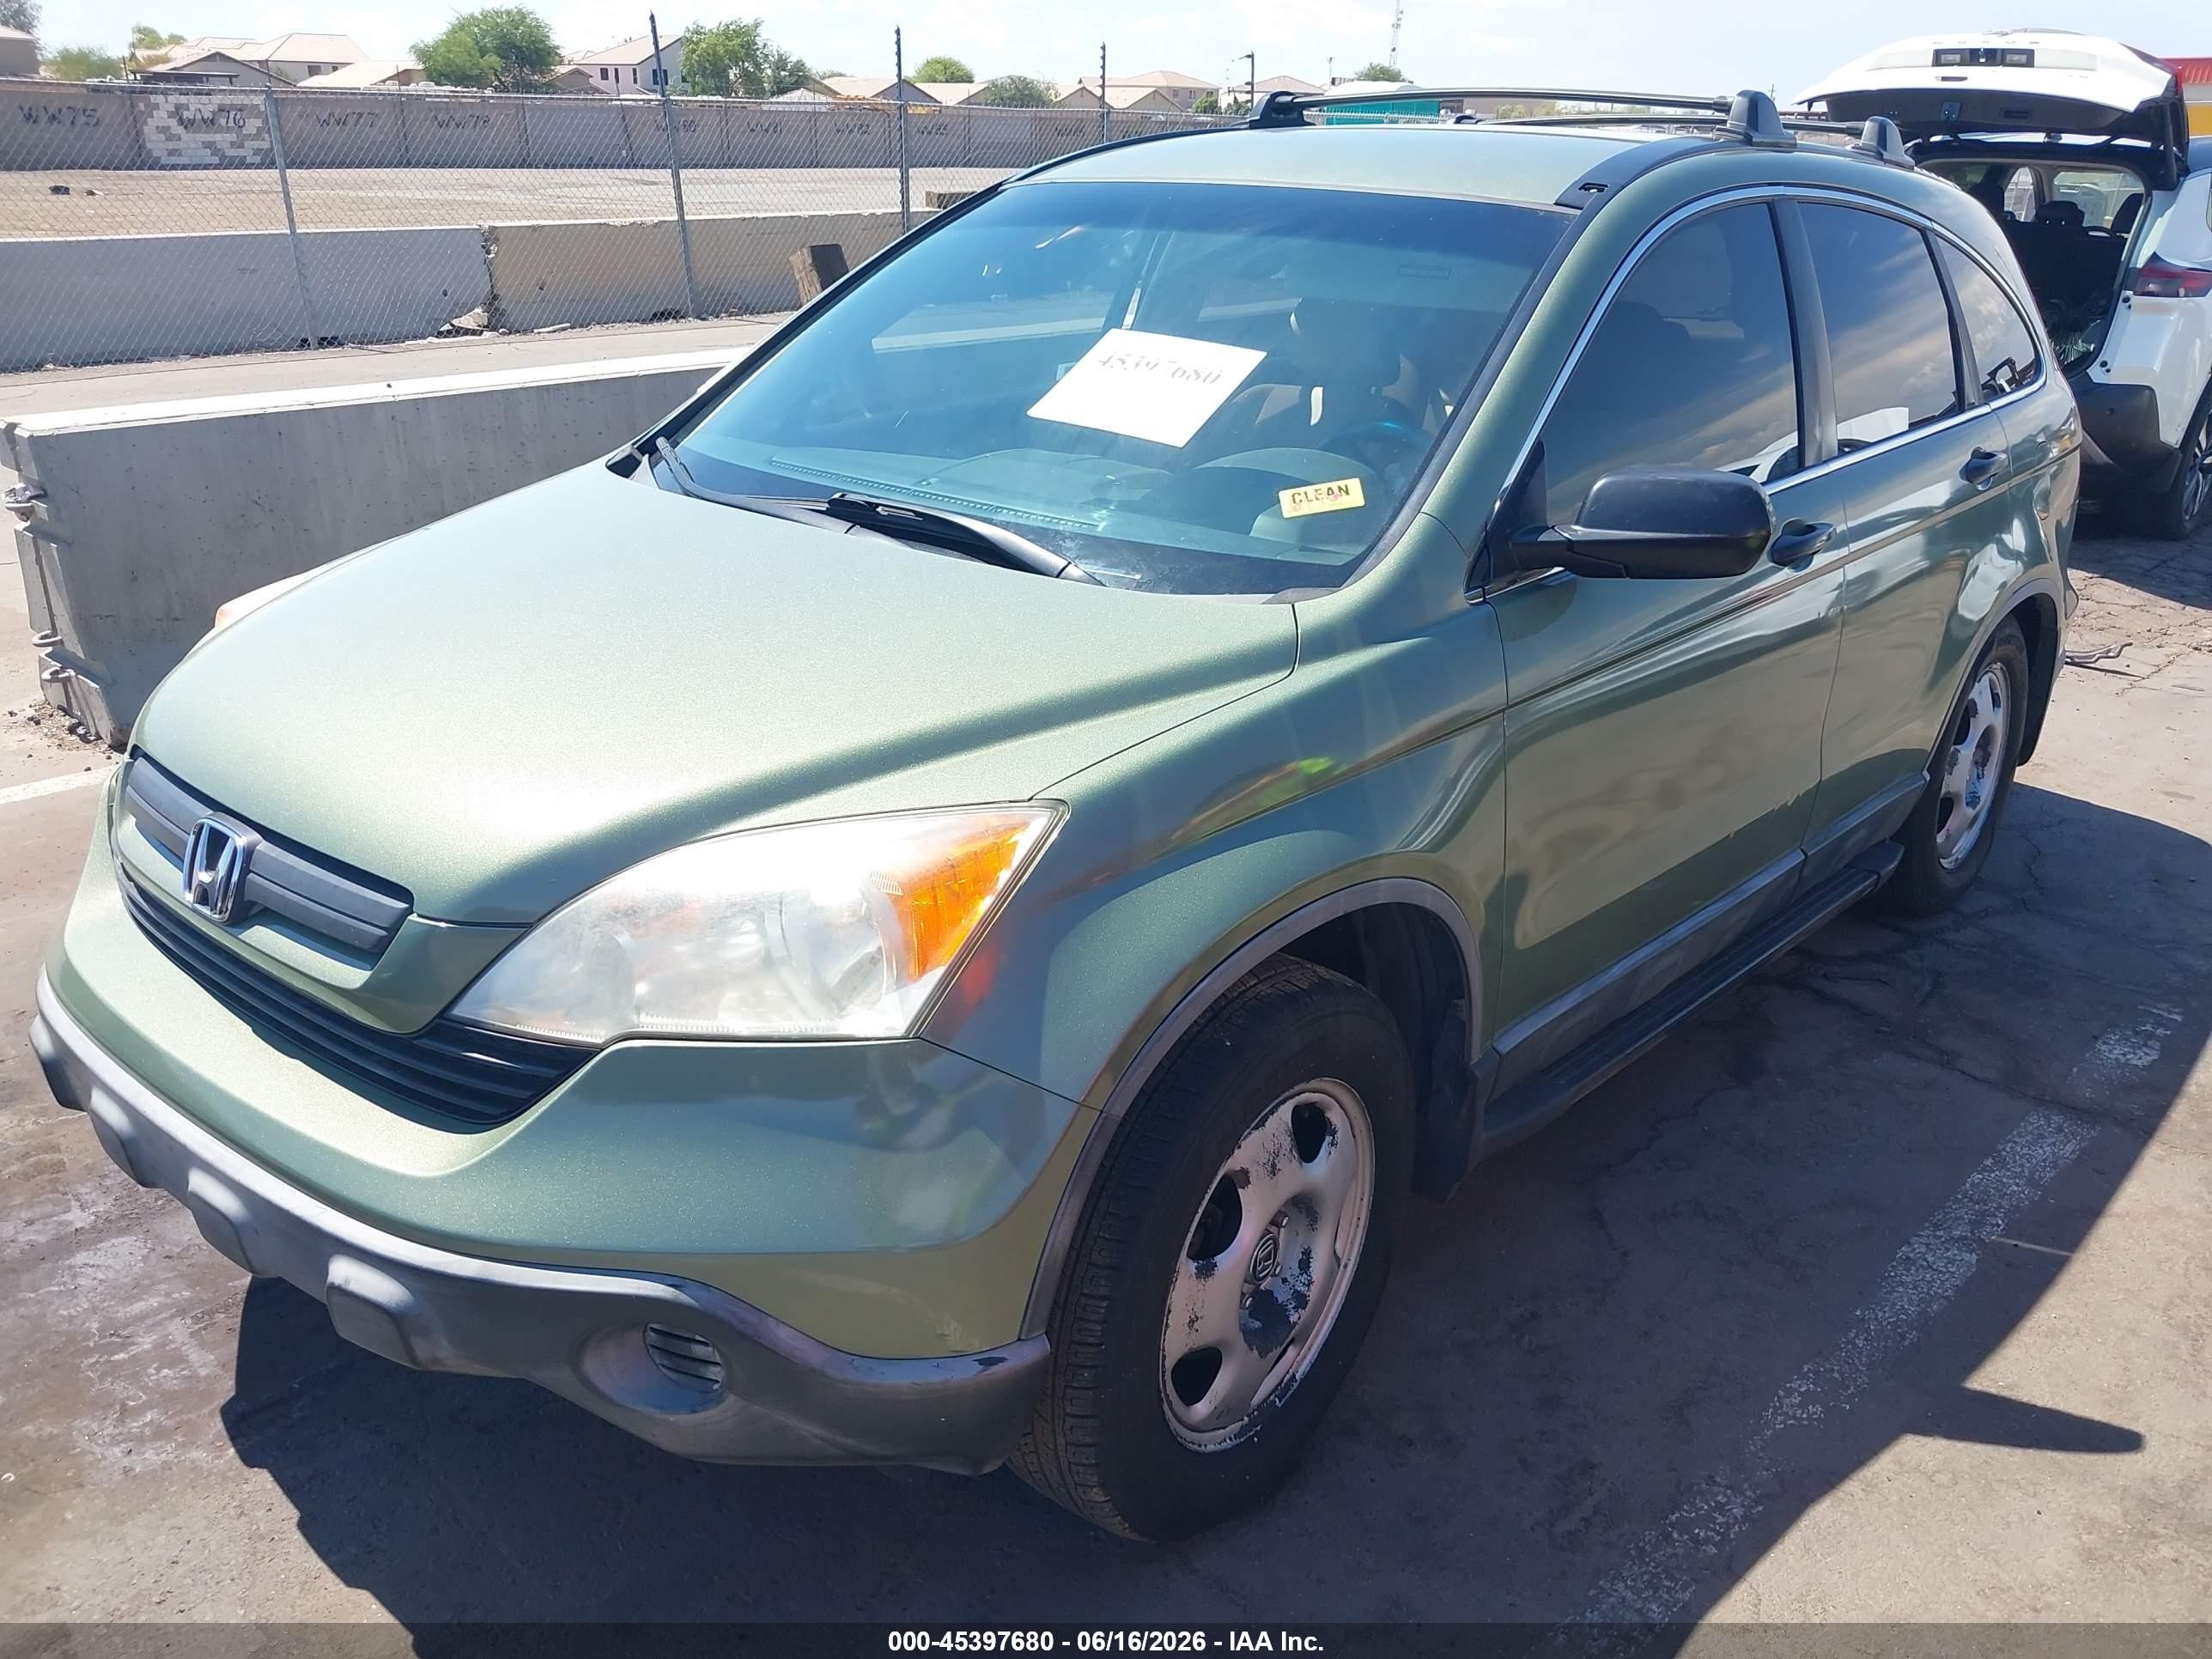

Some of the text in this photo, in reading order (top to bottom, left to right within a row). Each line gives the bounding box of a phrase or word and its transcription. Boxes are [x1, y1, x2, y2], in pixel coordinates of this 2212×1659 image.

[19, 105, 100, 127] WW75
[178, 108, 246, 129] WW76
[314, 112, 379, 128] WW77
[434, 114, 490, 129] WW78
[1291, 484, 1350, 504] CLEAN
